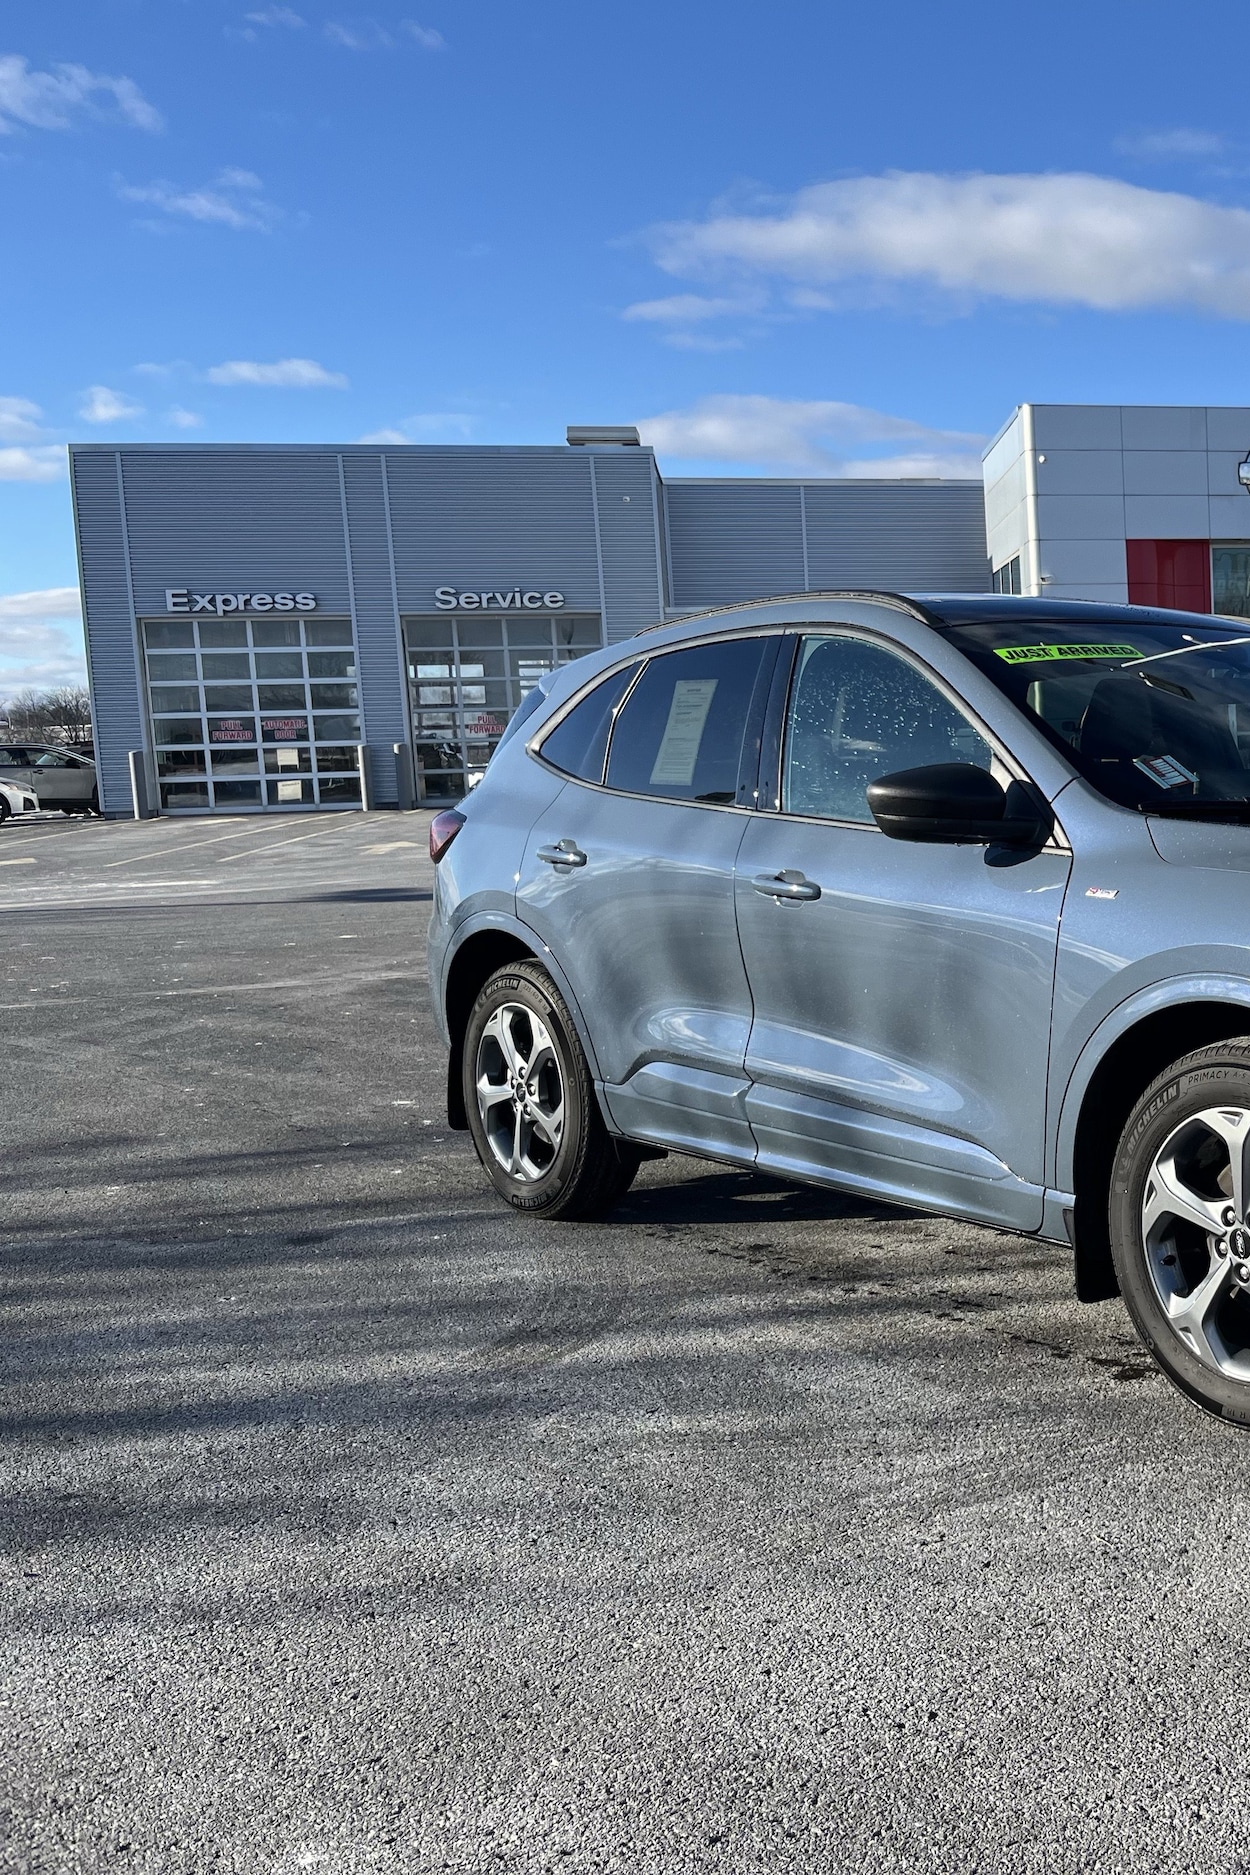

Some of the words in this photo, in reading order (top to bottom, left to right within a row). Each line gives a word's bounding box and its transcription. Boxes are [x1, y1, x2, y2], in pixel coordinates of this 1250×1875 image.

[165, 588, 317, 616] Express
[434, 586, 565, 610] Service
[1004, 648, 1053, 662] JUST
[1056, 646, 1138, 658] ARRIVED
[220, 720, 243, 730] PULL
[264, 719, 307, 730] AUTOMATIC
[477, 715, 498, 724] PULL
[212, 730, 253, 741] FORWARD
[274, 729, 298, 740] DOOR
[485, 979, 520, 997] MICHELIN
[1188, 1071, 1230, 1085] PRIMACY
[1127, 1083, 1178, 1155] MICHELIN
